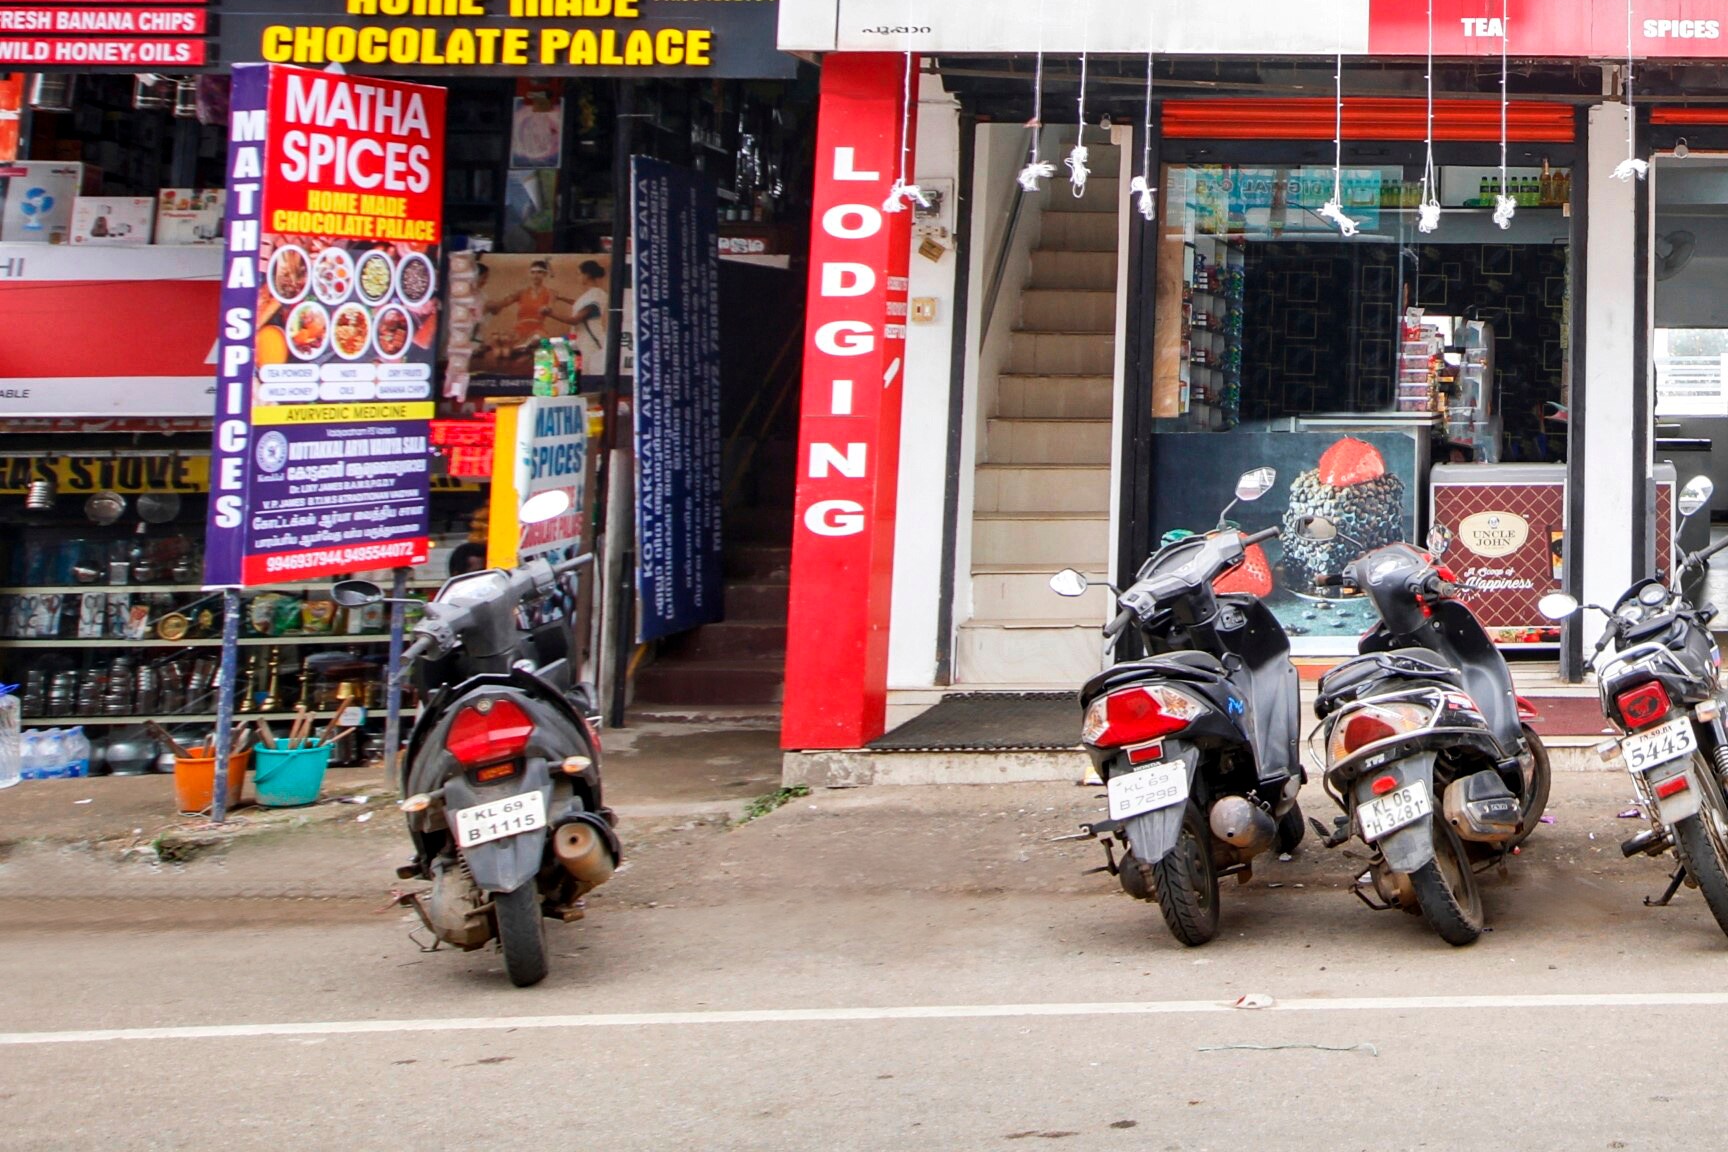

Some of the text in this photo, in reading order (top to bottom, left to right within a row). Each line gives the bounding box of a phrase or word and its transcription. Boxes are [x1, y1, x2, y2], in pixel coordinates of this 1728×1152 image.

[56, 11, 134, 31] BANANA
[138, 11, 197, 31] CHIPS
[1460, 17, 1504, 38] TEA
[1642, 19, 1720, 39] SPICES
[55, 41, 136, 63] HONEY,
[139, 42, 191, 62] OILS
[262, 24, 712, 67] CHOCOLATE PALACE
[284, 73, 431, 140] MATHA
[280, 129, 431, 195] SPICES
[307, 189, 408, 218] HOME MADE
[272, 209, 436, 241] CHOCOLATE PALACE
[214, 109, 267, 529] MATHA SPICES
[803, 145, 883, 538] LODGING
[638, 178, 654, 579] KOTTAKKAL ARYA VAIDYA SALA
[286, 404, 408, 422] AYURVEDIC MEDICINE
[529, 441, 584, 480] SPICES
[1472, 529, 1516, 539] UNCLE
[1476, 538, 1511, 547] JOHN
[1461, 576, 1534, 592] Happiness
[1631, 729, 1690, 768] 5443
[1119, 785, 1179, 811] B 7298
[1124, 774, 1170, 794] KL 69
[474, 800, 524, 821] KL 69
[1372, 788, 1412, 818] KL 06
[468, 813, 536, 842] B 1115
[1372, 820, 1384, 836] H
